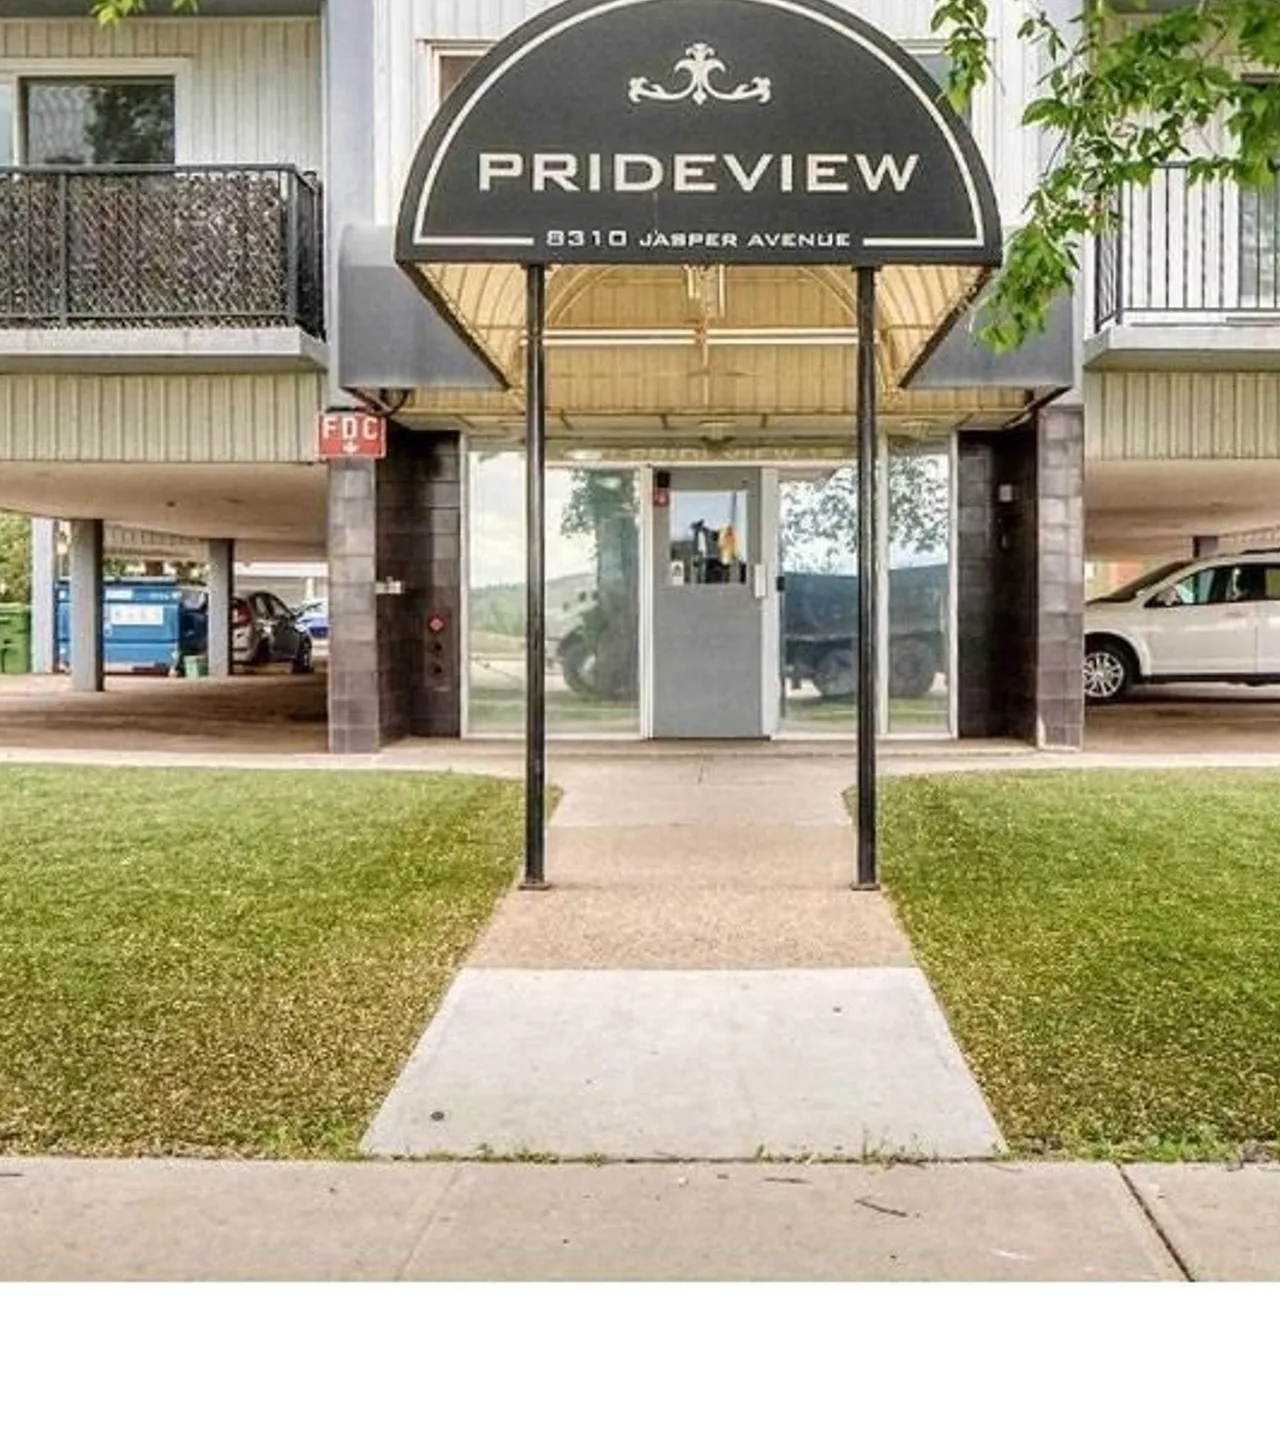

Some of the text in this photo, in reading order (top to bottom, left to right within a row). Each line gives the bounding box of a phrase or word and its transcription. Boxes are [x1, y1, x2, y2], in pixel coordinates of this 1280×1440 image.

[478, 152, 920, 194] PRIDEVIEW
[545, 229, 851, 248] 8310 JASPER AVENUE
[322, 416, 379, 440] FDC
